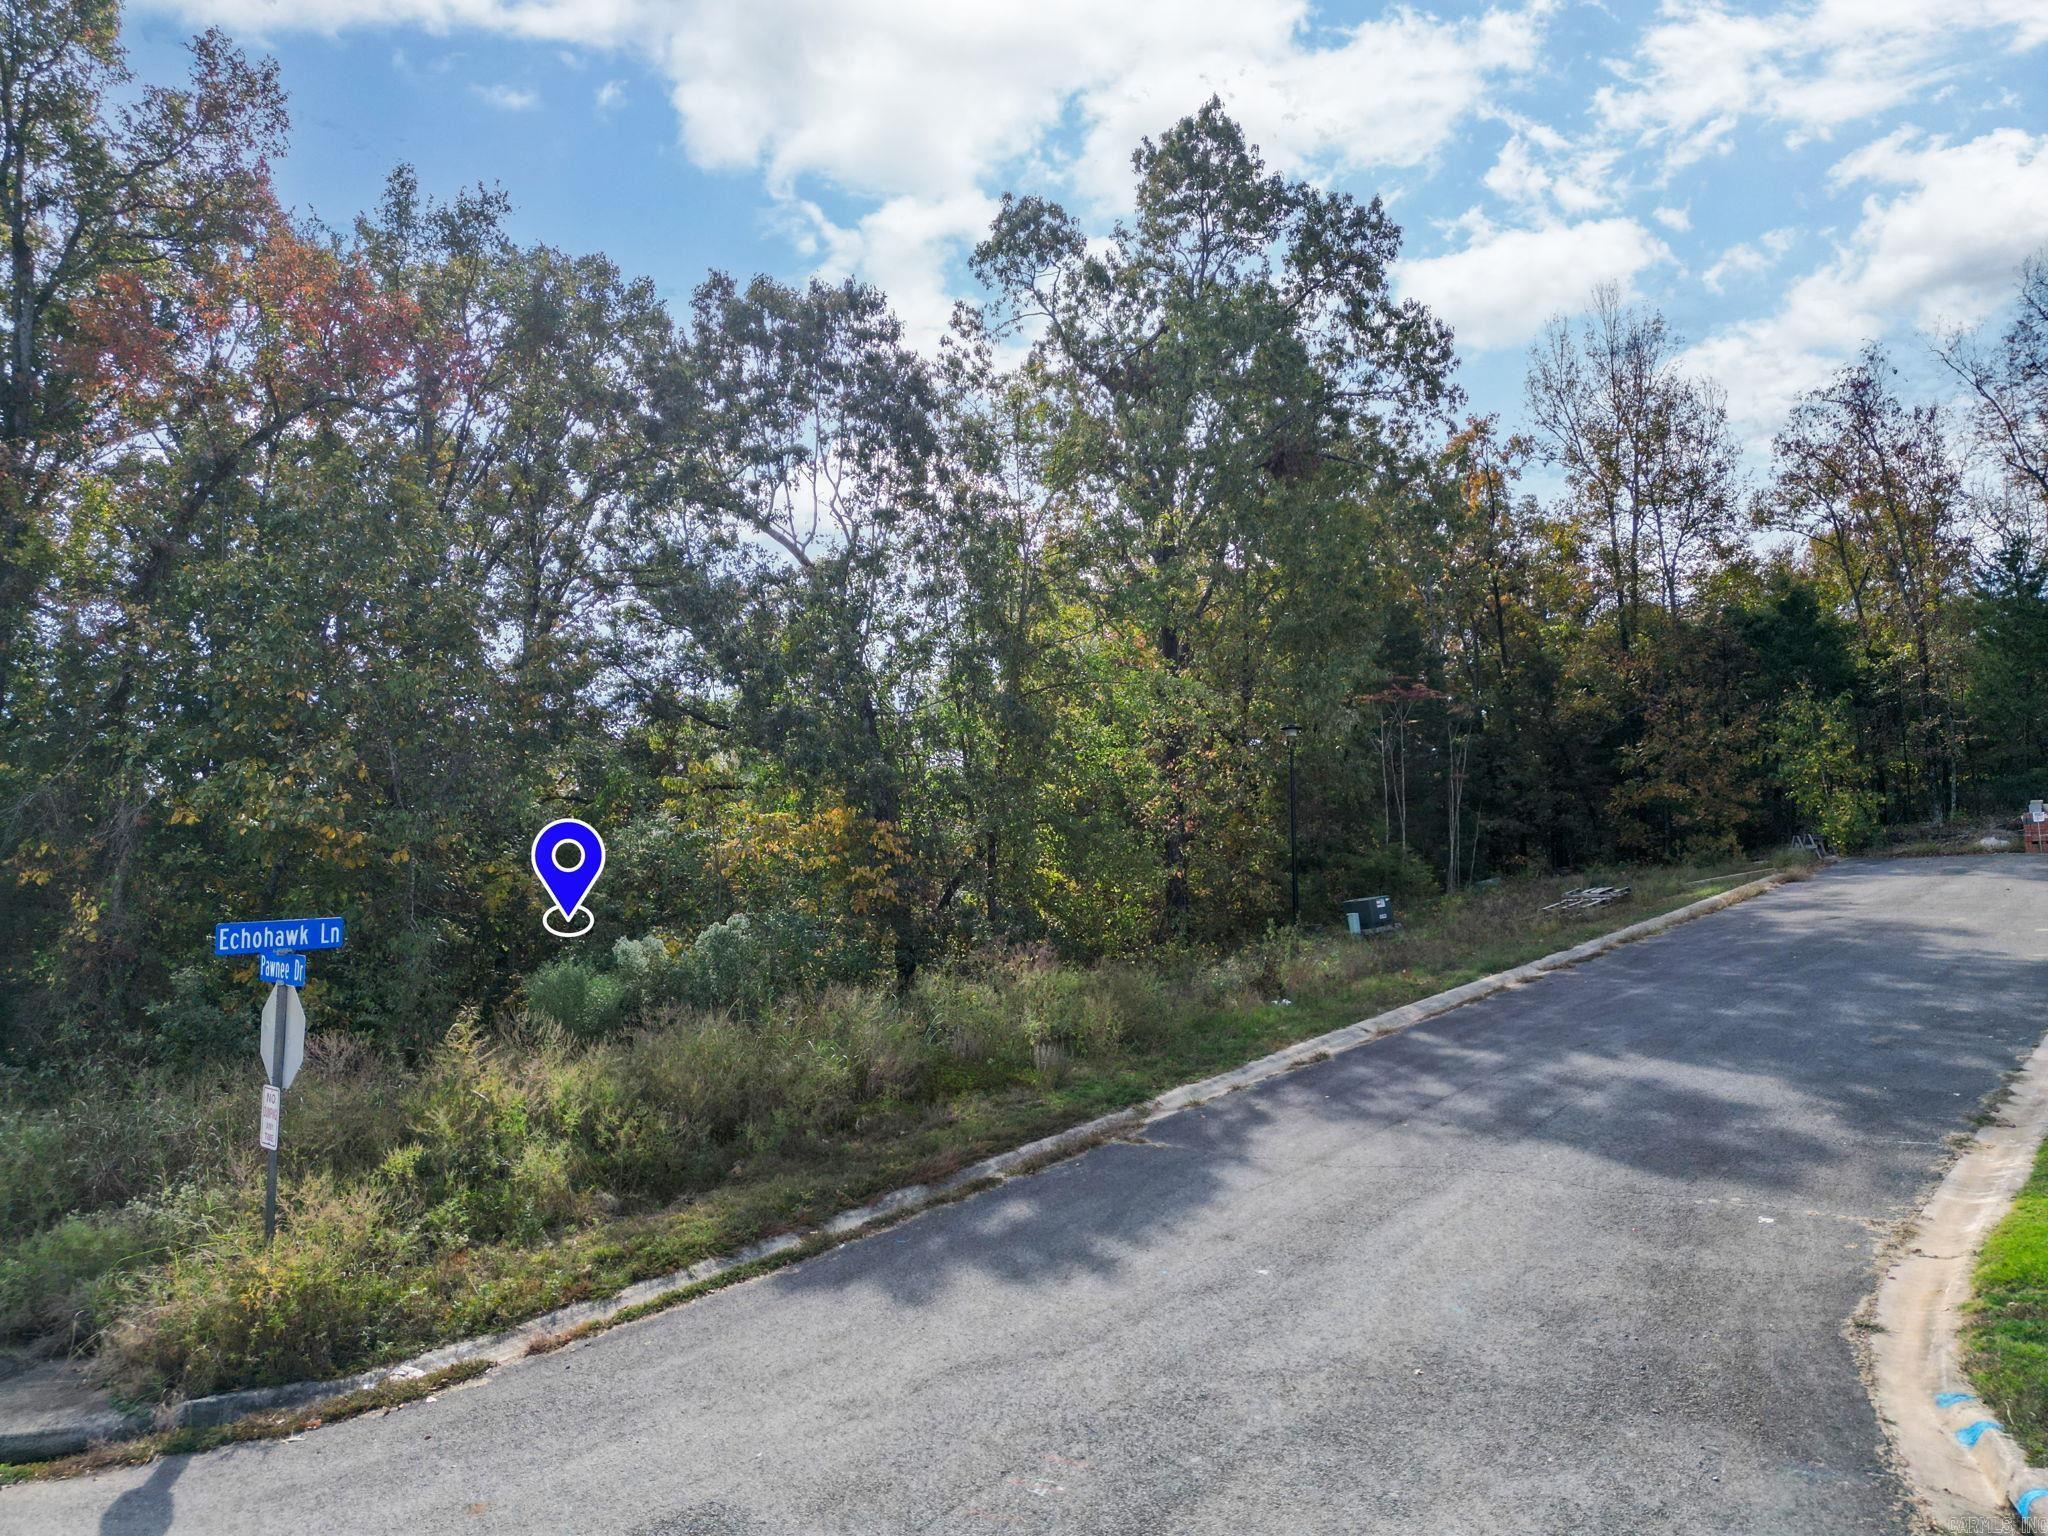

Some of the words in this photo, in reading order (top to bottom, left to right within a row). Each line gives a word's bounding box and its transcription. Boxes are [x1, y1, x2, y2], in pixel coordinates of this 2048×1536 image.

[219, 924, 309, 951] Echohawk
[321, 923, 340, 944] Ln
[260, 954, 290, 980] Pawnee
[293, 959, 304, 982] Dr
[266, 1092, 276, 1104] NO
